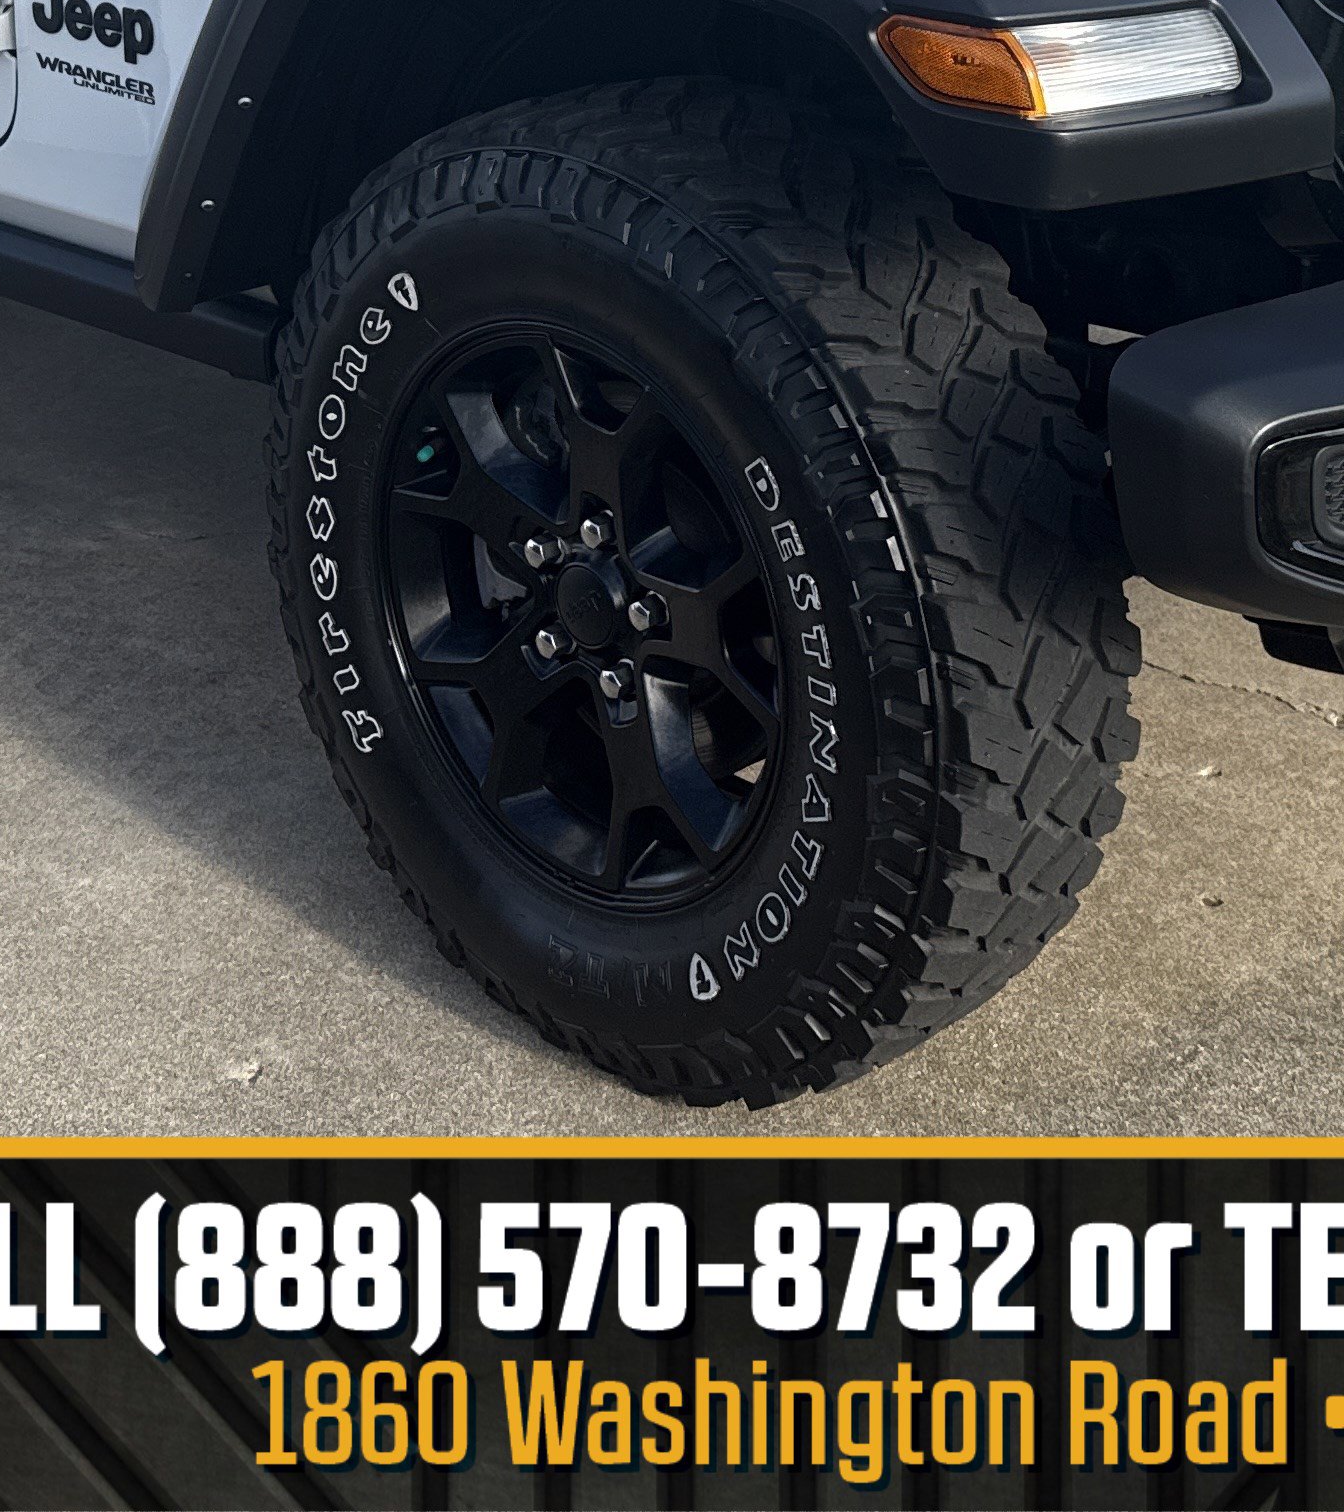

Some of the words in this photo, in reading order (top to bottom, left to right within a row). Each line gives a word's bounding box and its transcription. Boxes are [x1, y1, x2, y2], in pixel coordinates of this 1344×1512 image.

[35, 52, 156, 98] WRANGLER
[73, 77, 156, 106] UNLIMITED
[305, 307, 393, 754] Firestone
[717, 455, 839, 983] DESTINATION
